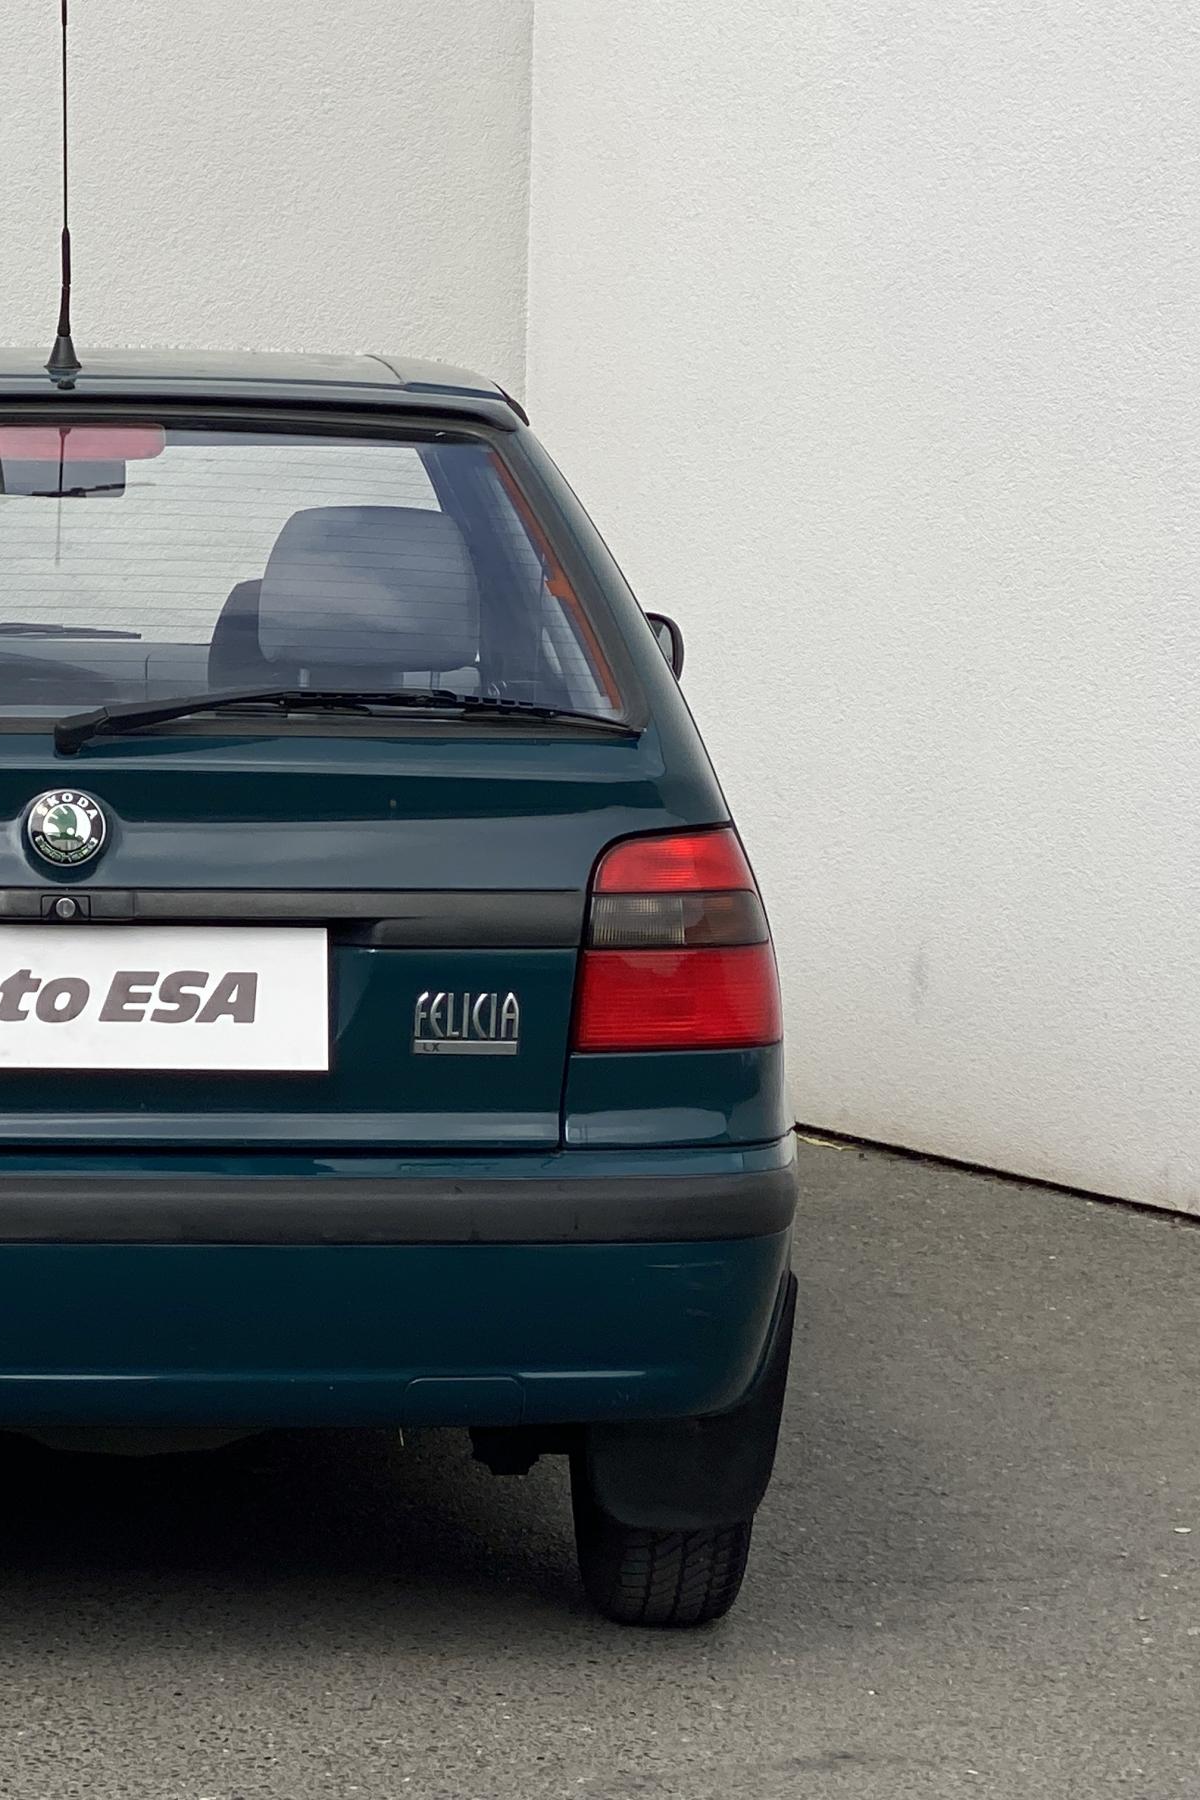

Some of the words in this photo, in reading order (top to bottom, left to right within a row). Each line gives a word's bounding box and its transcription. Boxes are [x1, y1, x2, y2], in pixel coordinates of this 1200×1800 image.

[98, 971, 258, 1023] ESA
[414, 992, 519, 1038] FELICIA
[422, 1042, 440, 1052] LX
